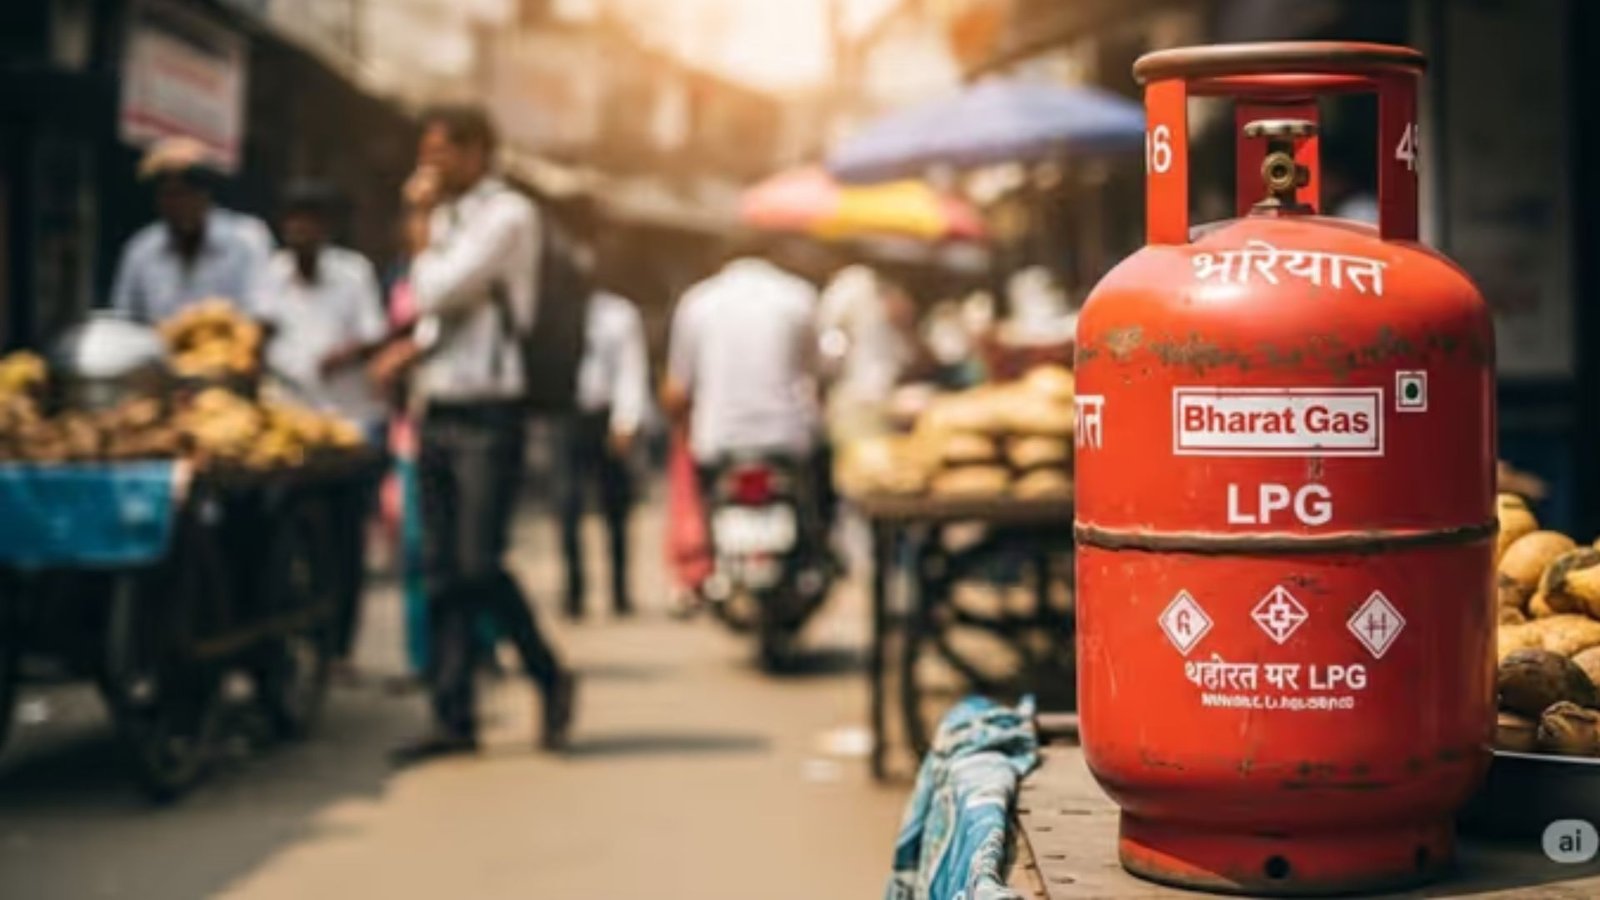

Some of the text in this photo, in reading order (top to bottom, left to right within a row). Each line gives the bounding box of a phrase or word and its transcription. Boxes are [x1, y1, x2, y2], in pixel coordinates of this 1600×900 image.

[1184, 404, 1370, 434] Bharat Gas
[1227, 483, 1333, 525] LPG
[1309, 664, 1367, 690] LPG
